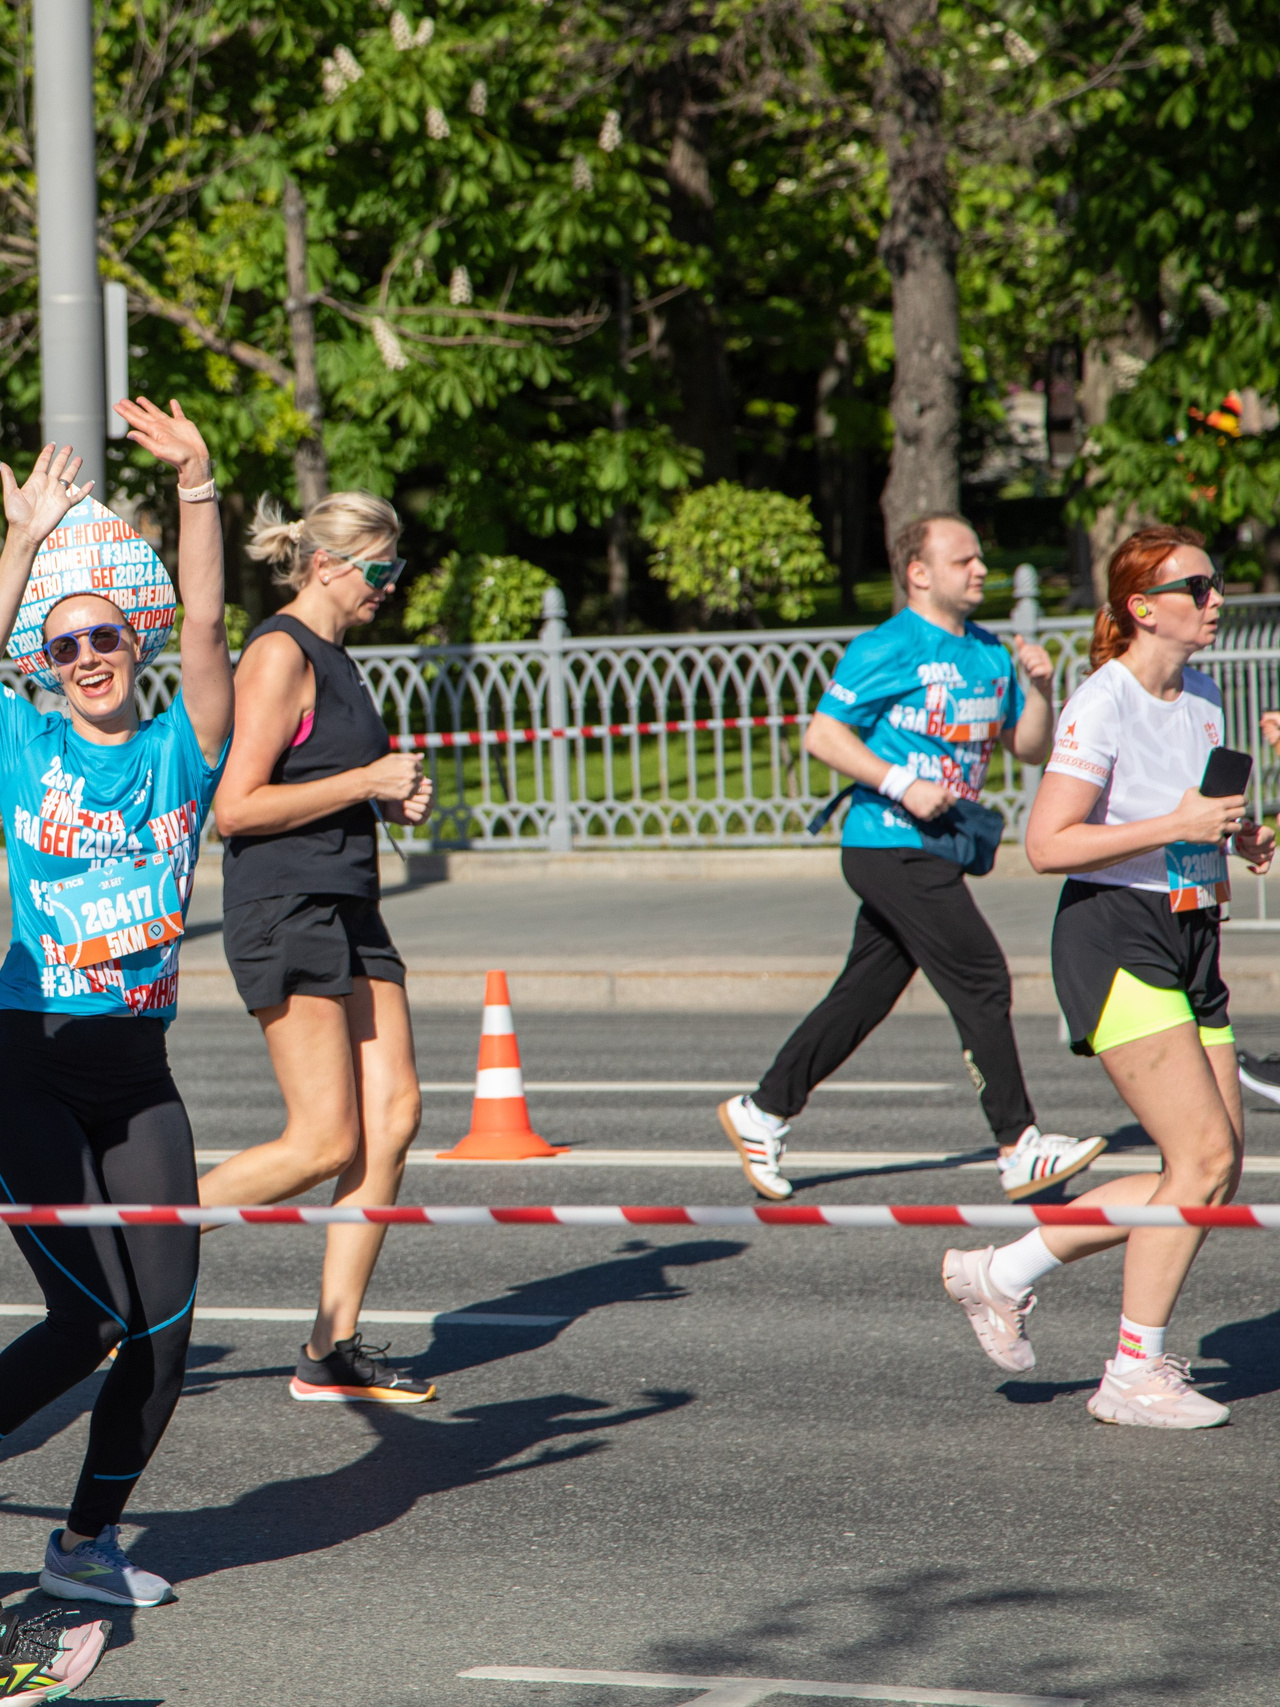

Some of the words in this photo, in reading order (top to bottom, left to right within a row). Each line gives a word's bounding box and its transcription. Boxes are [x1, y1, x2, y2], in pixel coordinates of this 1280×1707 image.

[63, 562, 154, 594] #ЗАБЕГ2024
[14, 804, 143, 859] #ЗАБЕГ2024
[65, 877, 85, 890] ПСБ
[80, 884, 155, 936] 26417
[105, 923, 148, 960] 5KM
[150, 924, 163, 938] D
